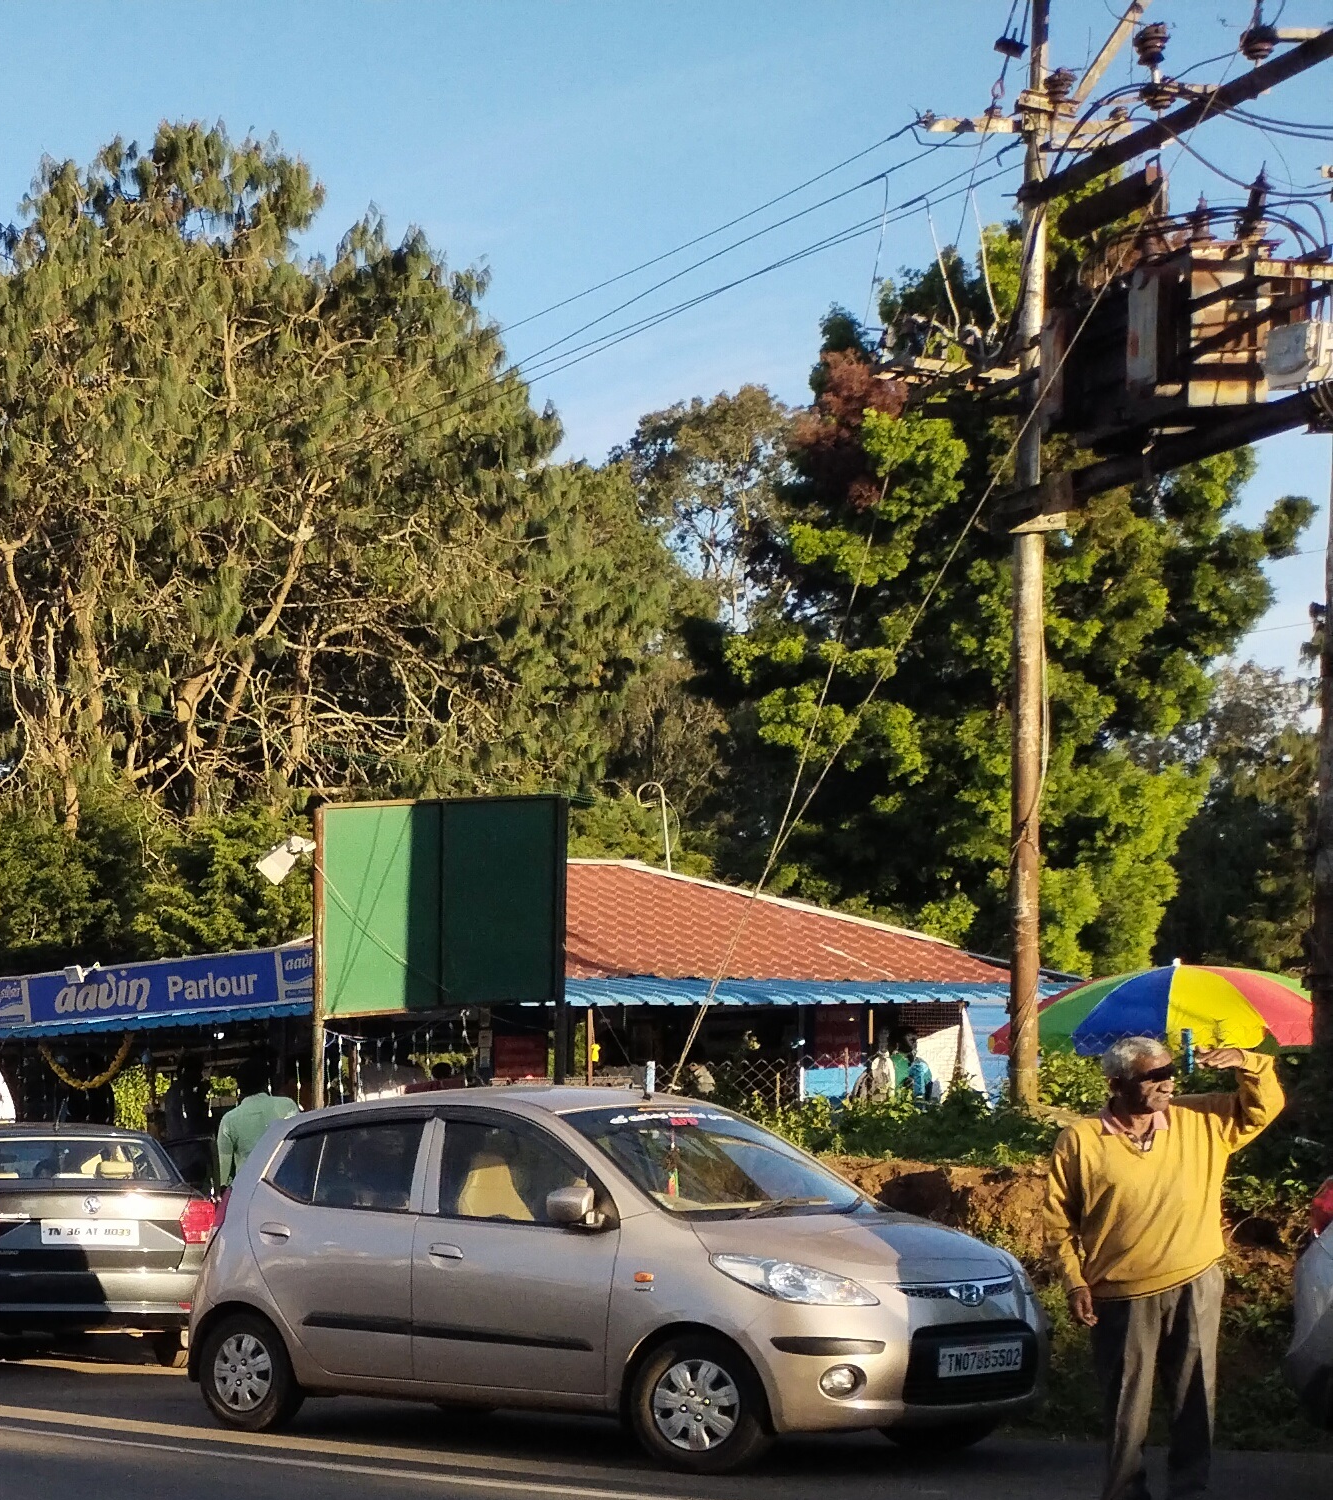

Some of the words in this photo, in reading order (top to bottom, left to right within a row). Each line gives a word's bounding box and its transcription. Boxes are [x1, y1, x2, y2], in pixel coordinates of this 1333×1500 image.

[285, 952, 313, 971] aavi
[54, 969, 151, 1014] aavin
[167, 972, 258, 1002] Parlour
[47, 1227, 62, 1236] TN
[66, 1227, 80, 1236] 36
[85, 1227, 98, 1236] AT
[103, 1227, 131, 1237] 8033
